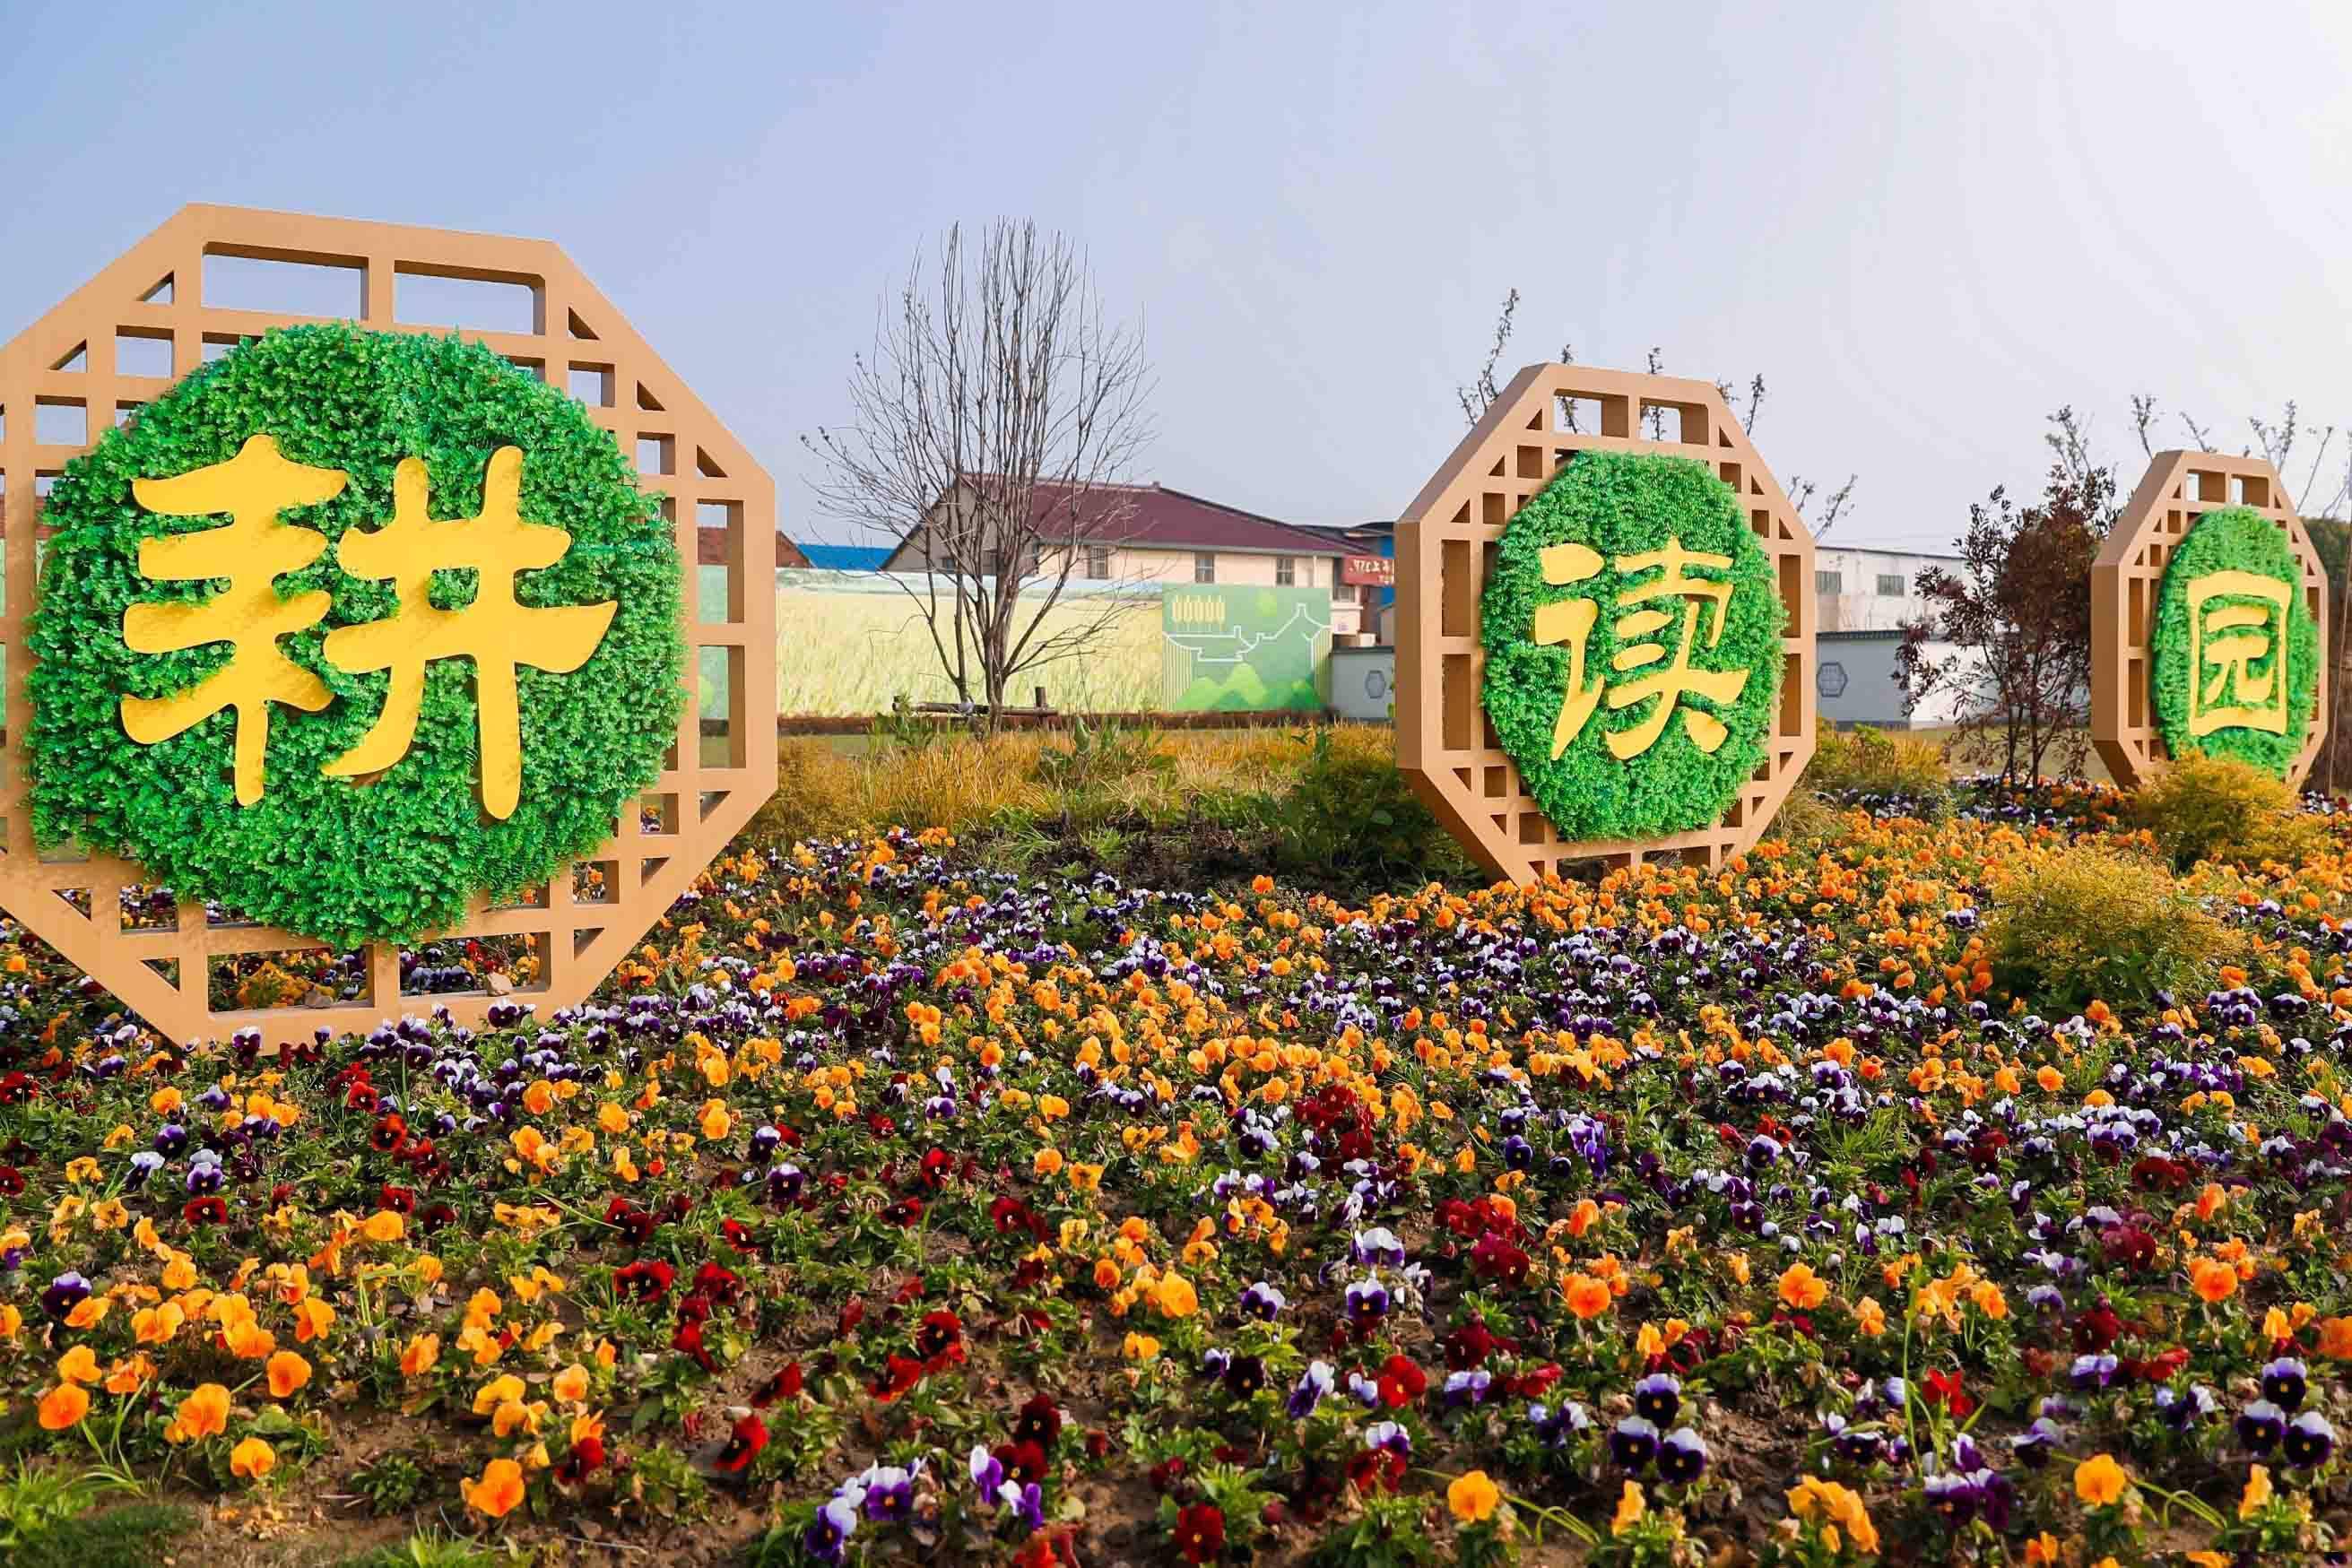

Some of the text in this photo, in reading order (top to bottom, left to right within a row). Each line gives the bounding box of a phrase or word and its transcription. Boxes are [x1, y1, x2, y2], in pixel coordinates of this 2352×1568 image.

[121, 434, 618, 819] 耕
[1534, 537, 1749, 760] 读
[2187, 570, 2291, 735] 园
